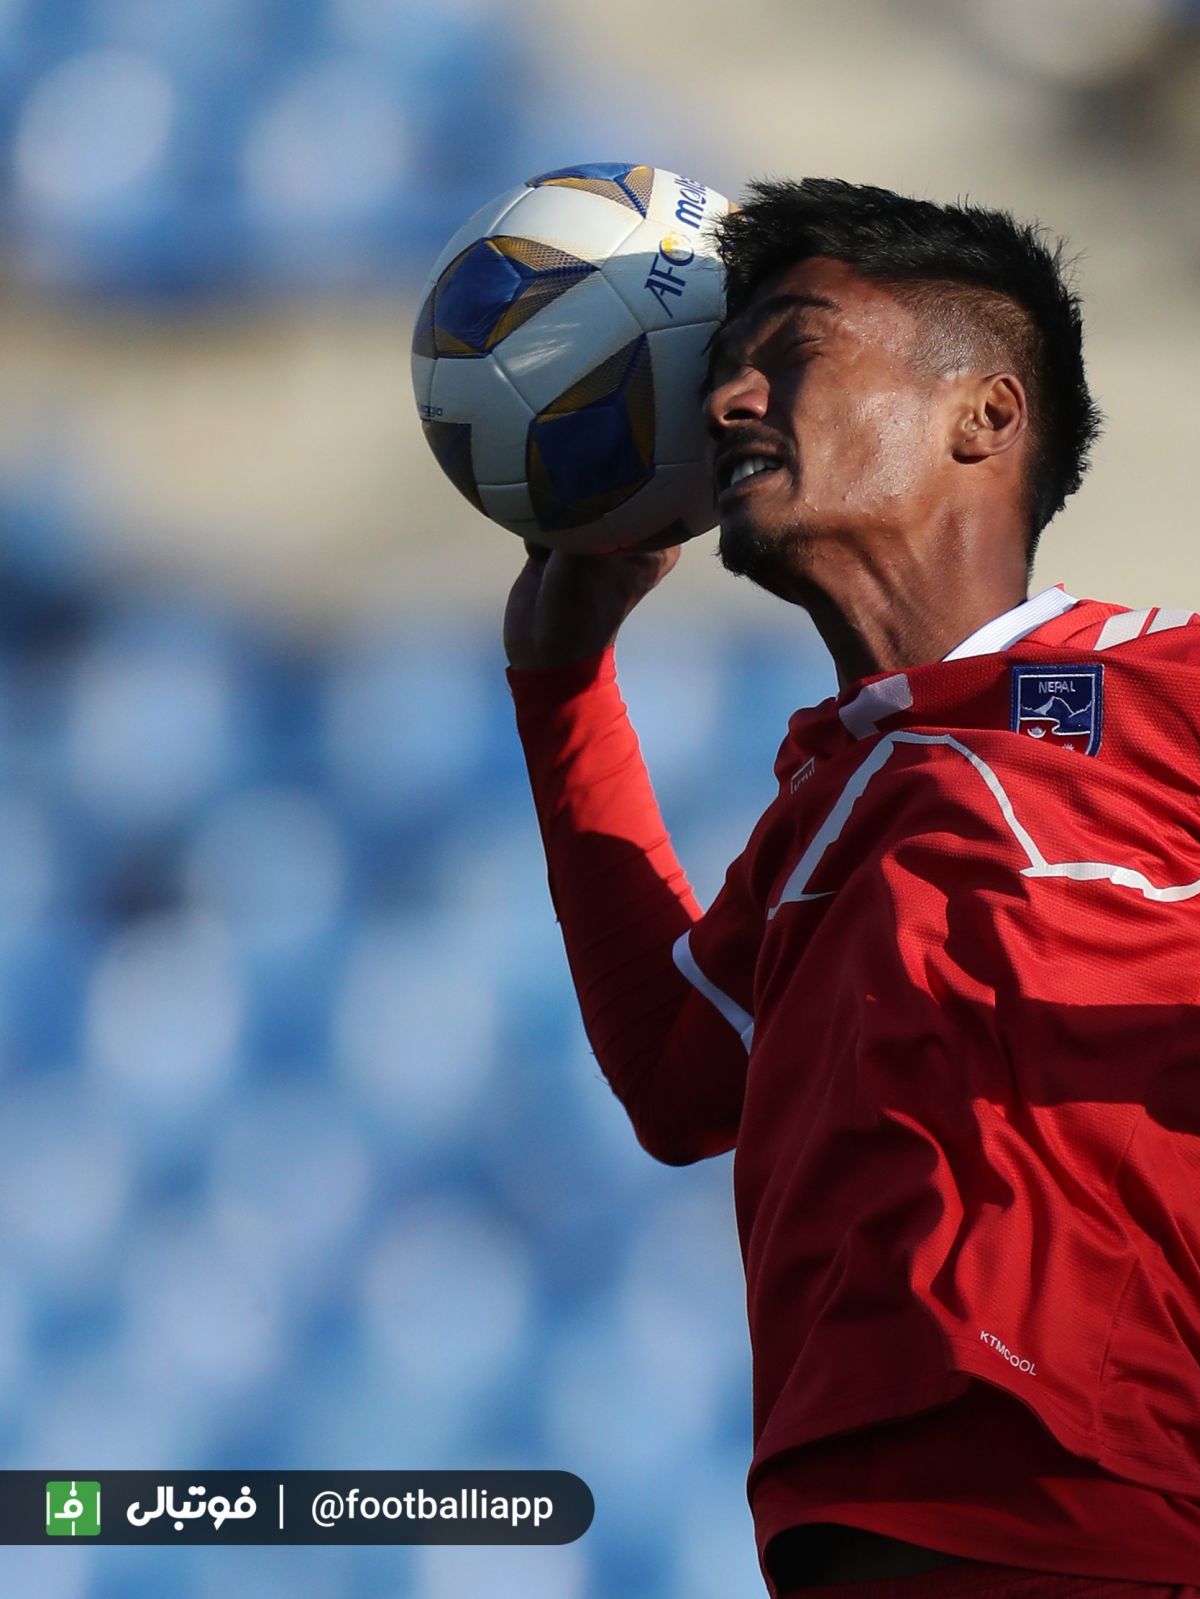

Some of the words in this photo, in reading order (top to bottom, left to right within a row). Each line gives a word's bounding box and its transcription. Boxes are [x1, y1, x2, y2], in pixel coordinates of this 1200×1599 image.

[644, 232, 695, 319] AFC
[1038, 680, 1076, 694] NEPAL
[980, 1330, 1037, 1377] KTMCOOL
